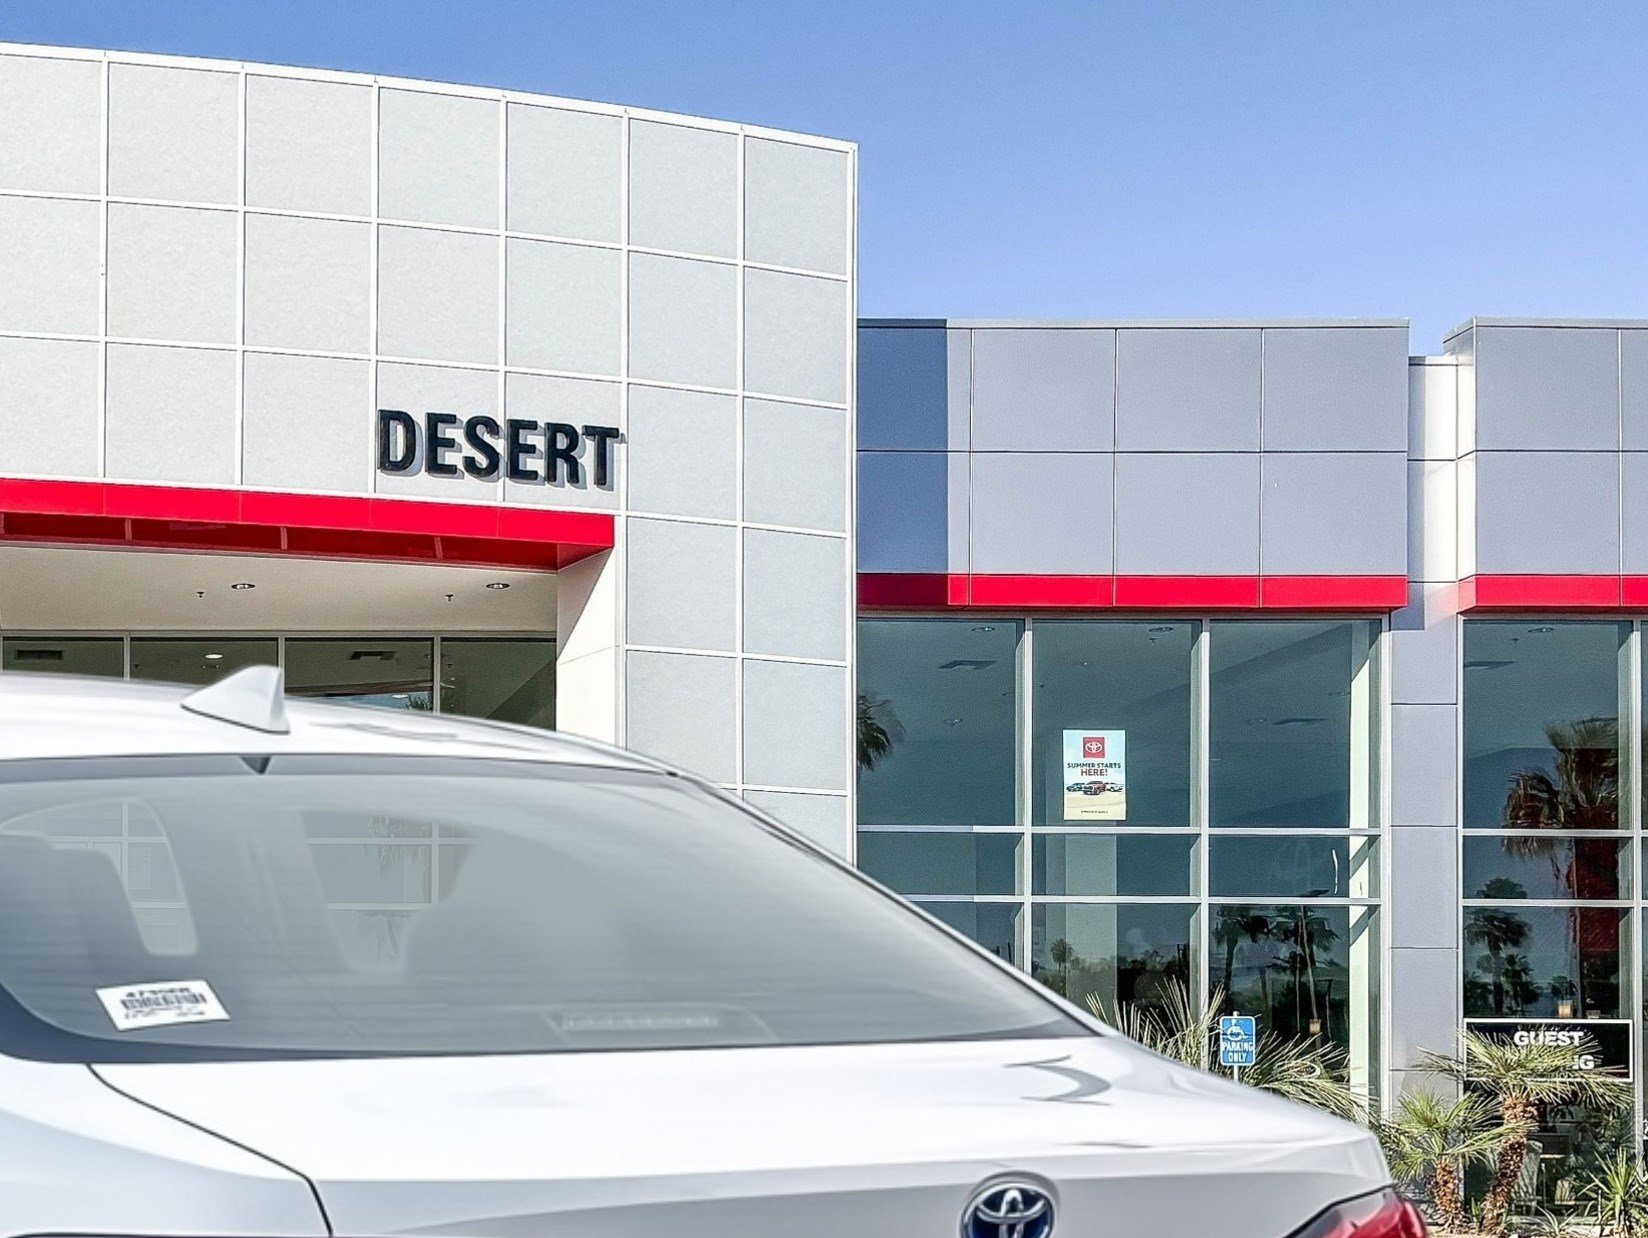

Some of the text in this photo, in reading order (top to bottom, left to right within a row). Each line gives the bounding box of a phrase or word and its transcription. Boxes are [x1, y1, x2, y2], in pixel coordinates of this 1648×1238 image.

[377, 408, 622, 487] DESERT
[1513, 1030, 1584, 1047] GUEST
[1221, 1041, 1254, 1052] PARKING
[1228, 1052, 1247, 1062] ONLY
